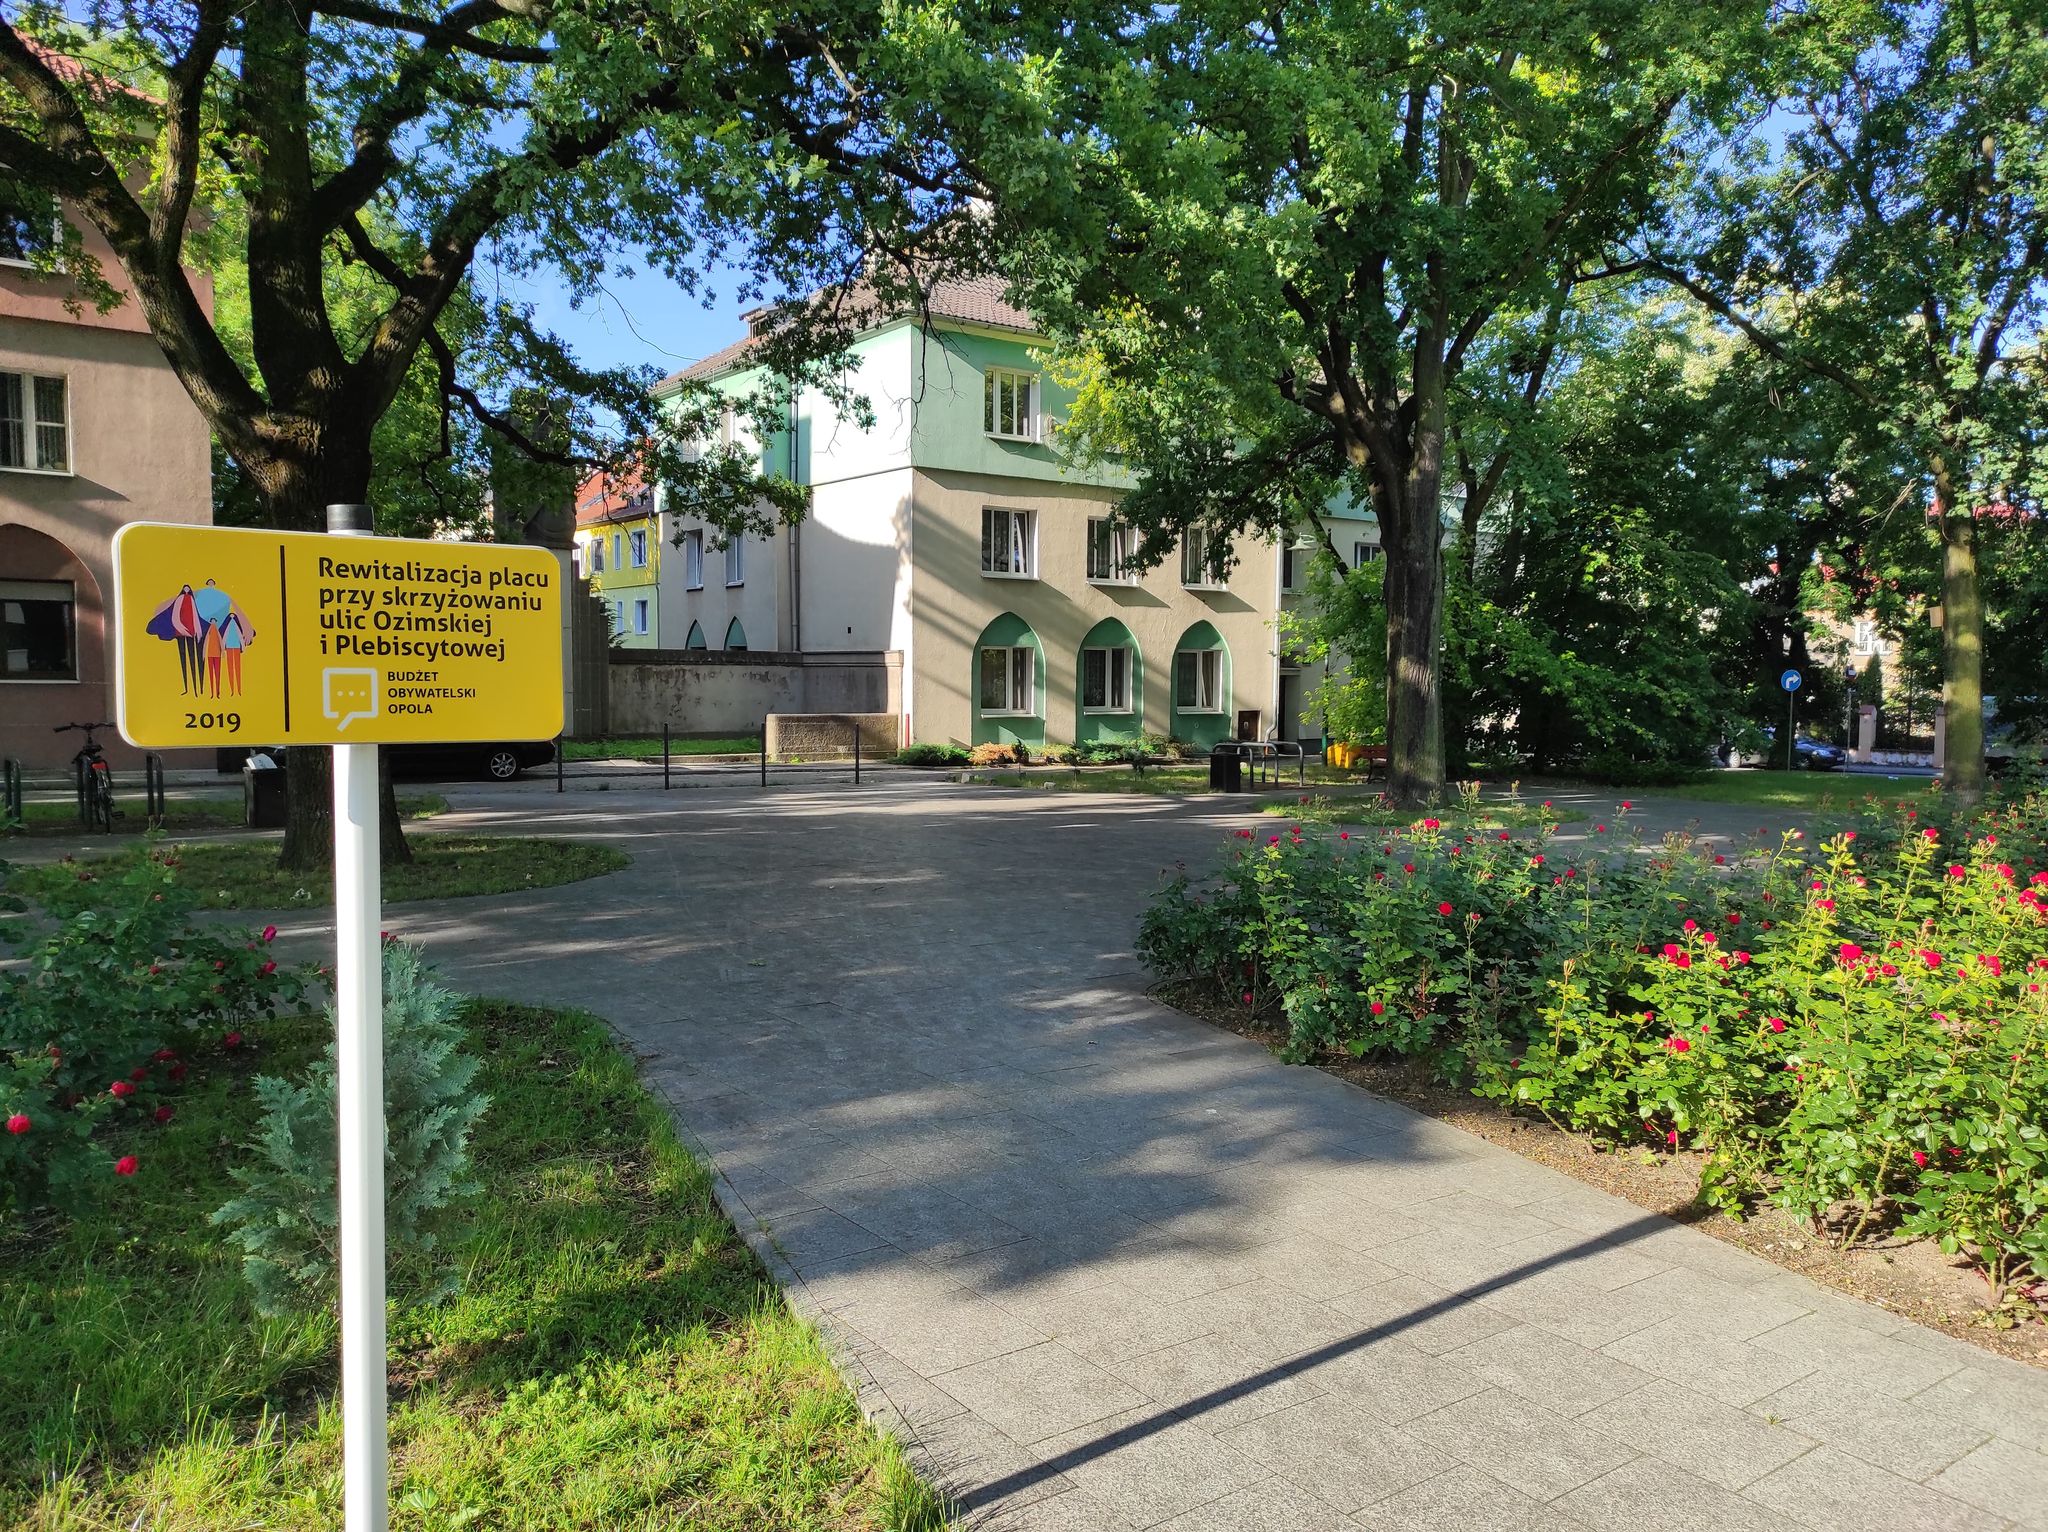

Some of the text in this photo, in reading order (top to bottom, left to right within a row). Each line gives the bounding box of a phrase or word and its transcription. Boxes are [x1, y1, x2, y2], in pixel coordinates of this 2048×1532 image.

[318, 556, 549, 590] Rewitalizacja placu
[319, 585, 542, 613] przy skrzyżowaniu
[319, 610, 492, 638] ulic Ozimskiej
[319, 633, 505, 662] i Plebiscytowej
[387, 670, 439, 682] BUDŻET
[387, 687, 476, 699] OBYWATELSKI
[387, 703, 433, 714] OPOLA
[185, 712, 241, 733] 2019
